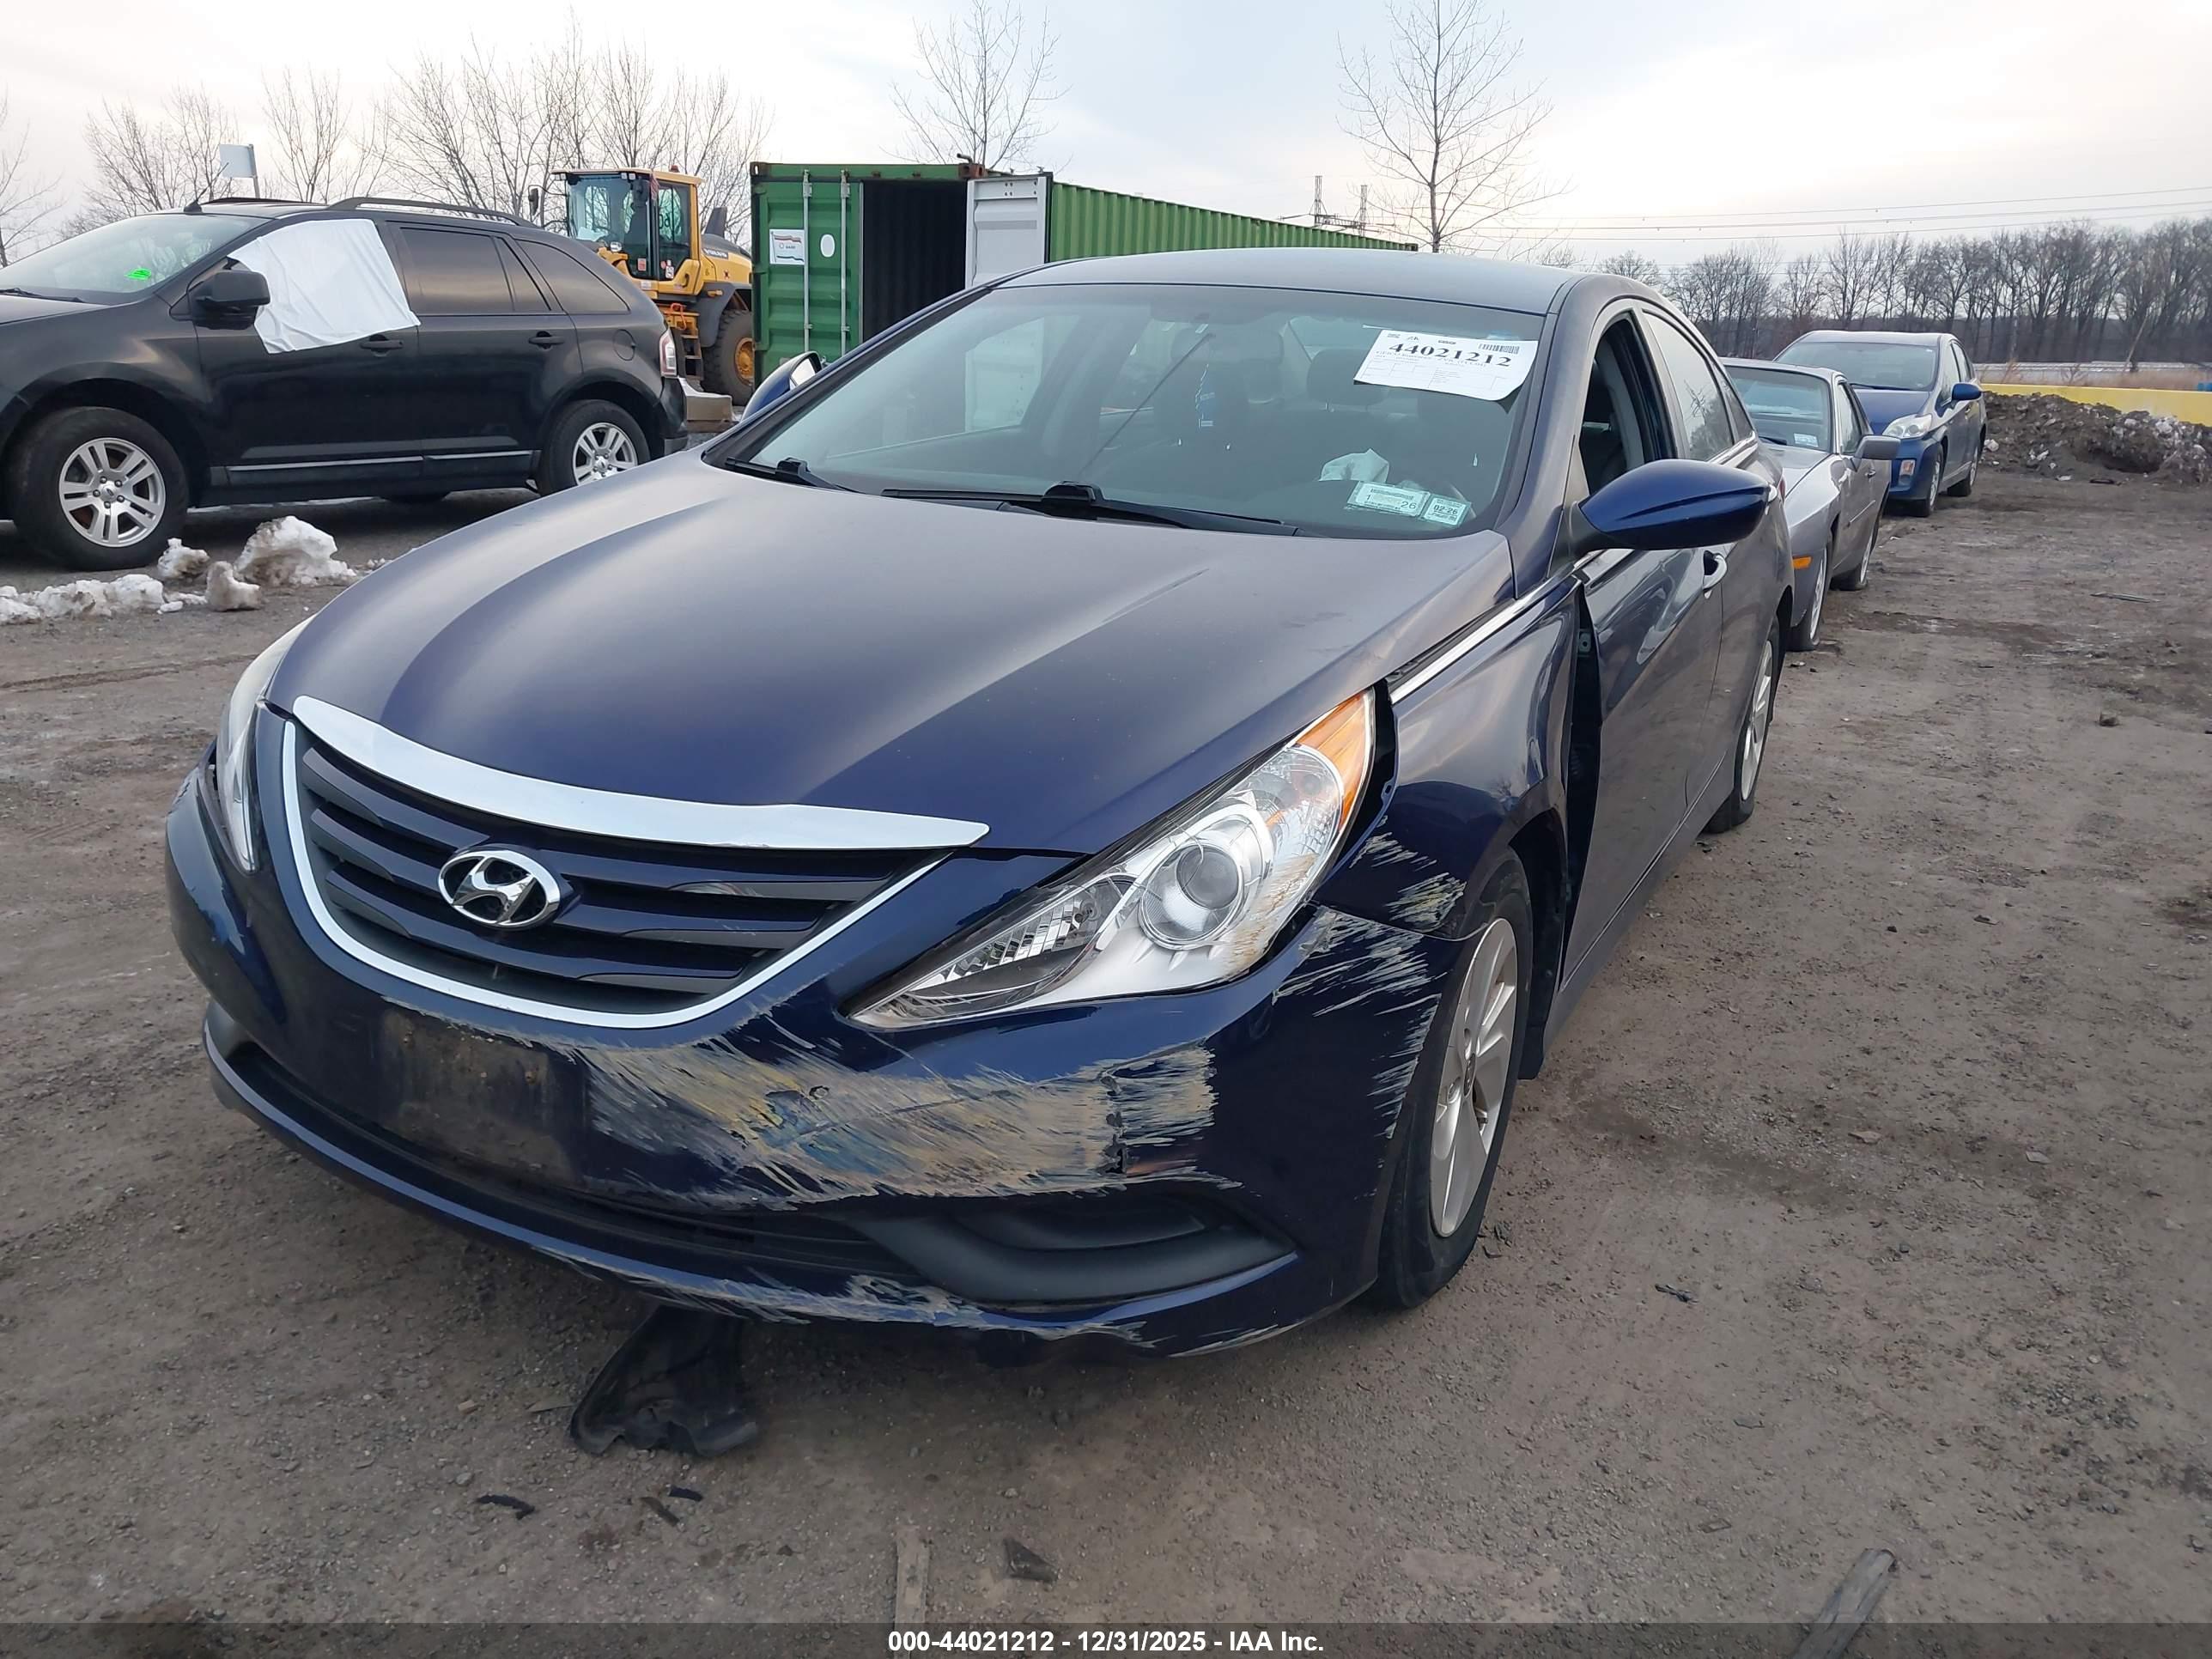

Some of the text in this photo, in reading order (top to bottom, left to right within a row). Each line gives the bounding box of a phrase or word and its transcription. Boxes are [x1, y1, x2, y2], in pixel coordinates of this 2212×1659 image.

[1389, 343, 1511, 367] 44021212
[1401, 501, 1417, 509] 26
[1434, 504, 1458, 515] 02-26
